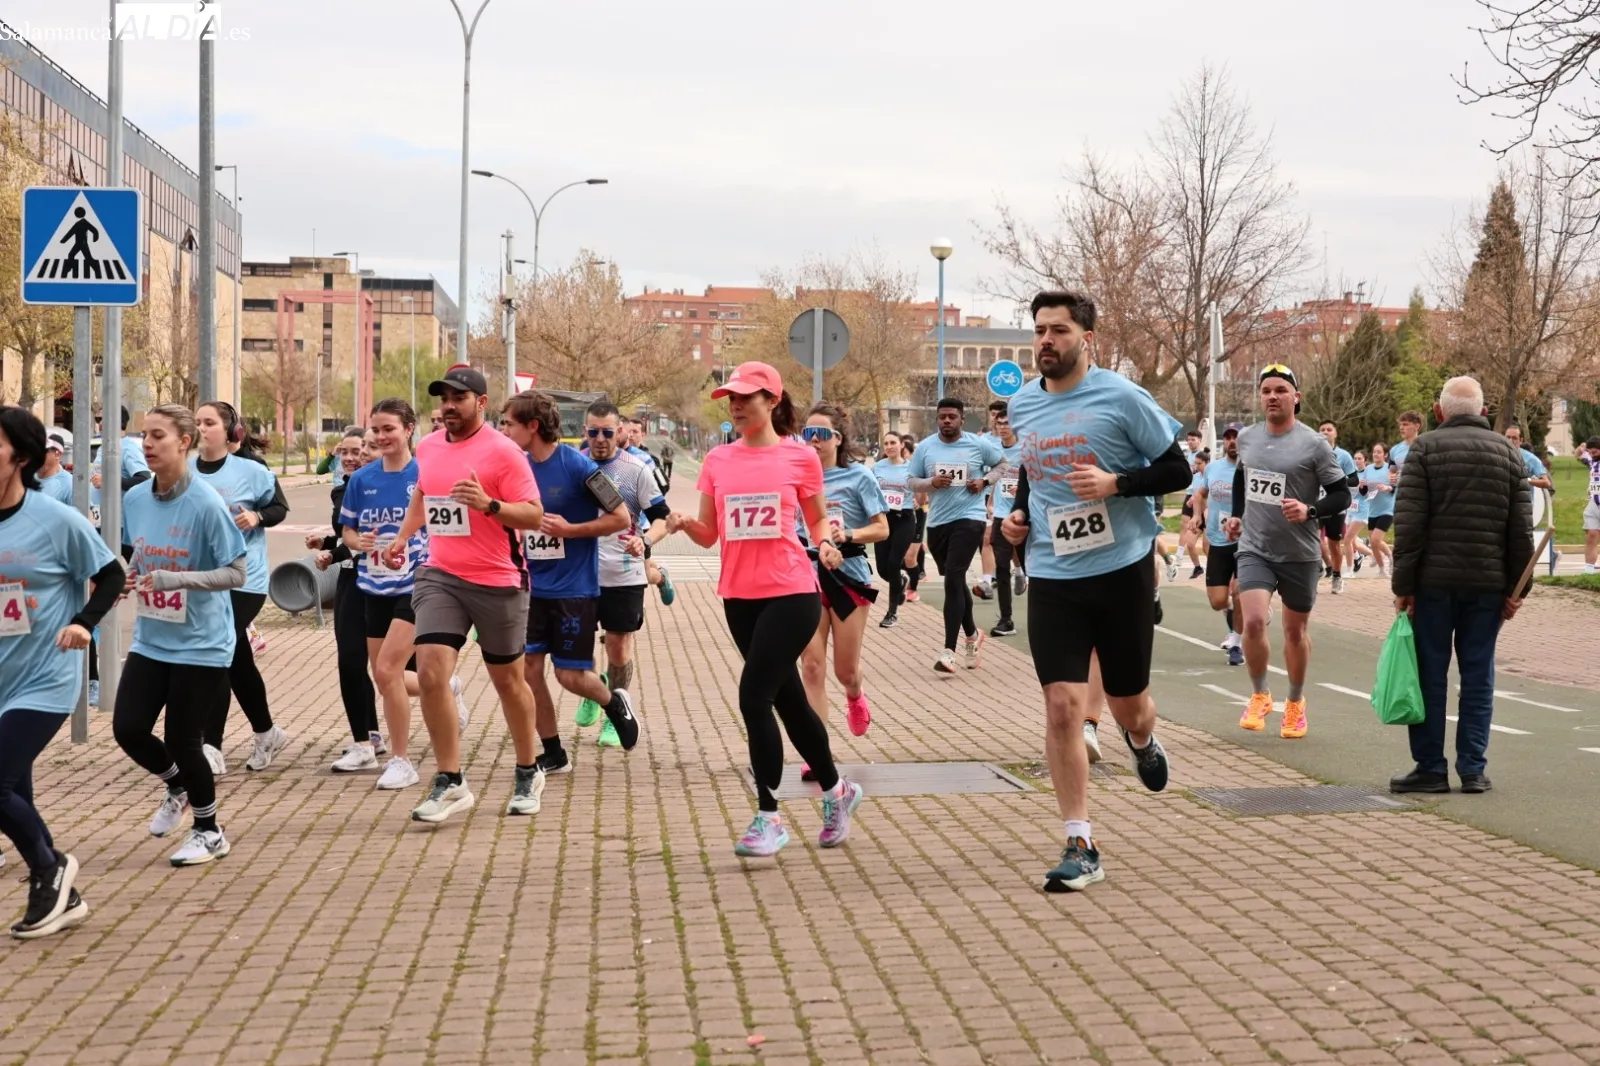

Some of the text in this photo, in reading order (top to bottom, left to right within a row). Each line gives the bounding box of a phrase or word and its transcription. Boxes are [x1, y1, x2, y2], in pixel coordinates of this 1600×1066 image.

[1250, 478, 1282, 497] 376
[360, 506, 409, 523] CHAP
[428, 507, 463, 525] 291
[730, 506, 777, 528] 172
[1056, 512, 1106, 541] 428
[528, 535, 560, 550] 344
[370, 550, 406, 567] 15
[139, 590, 183, 611] 184
